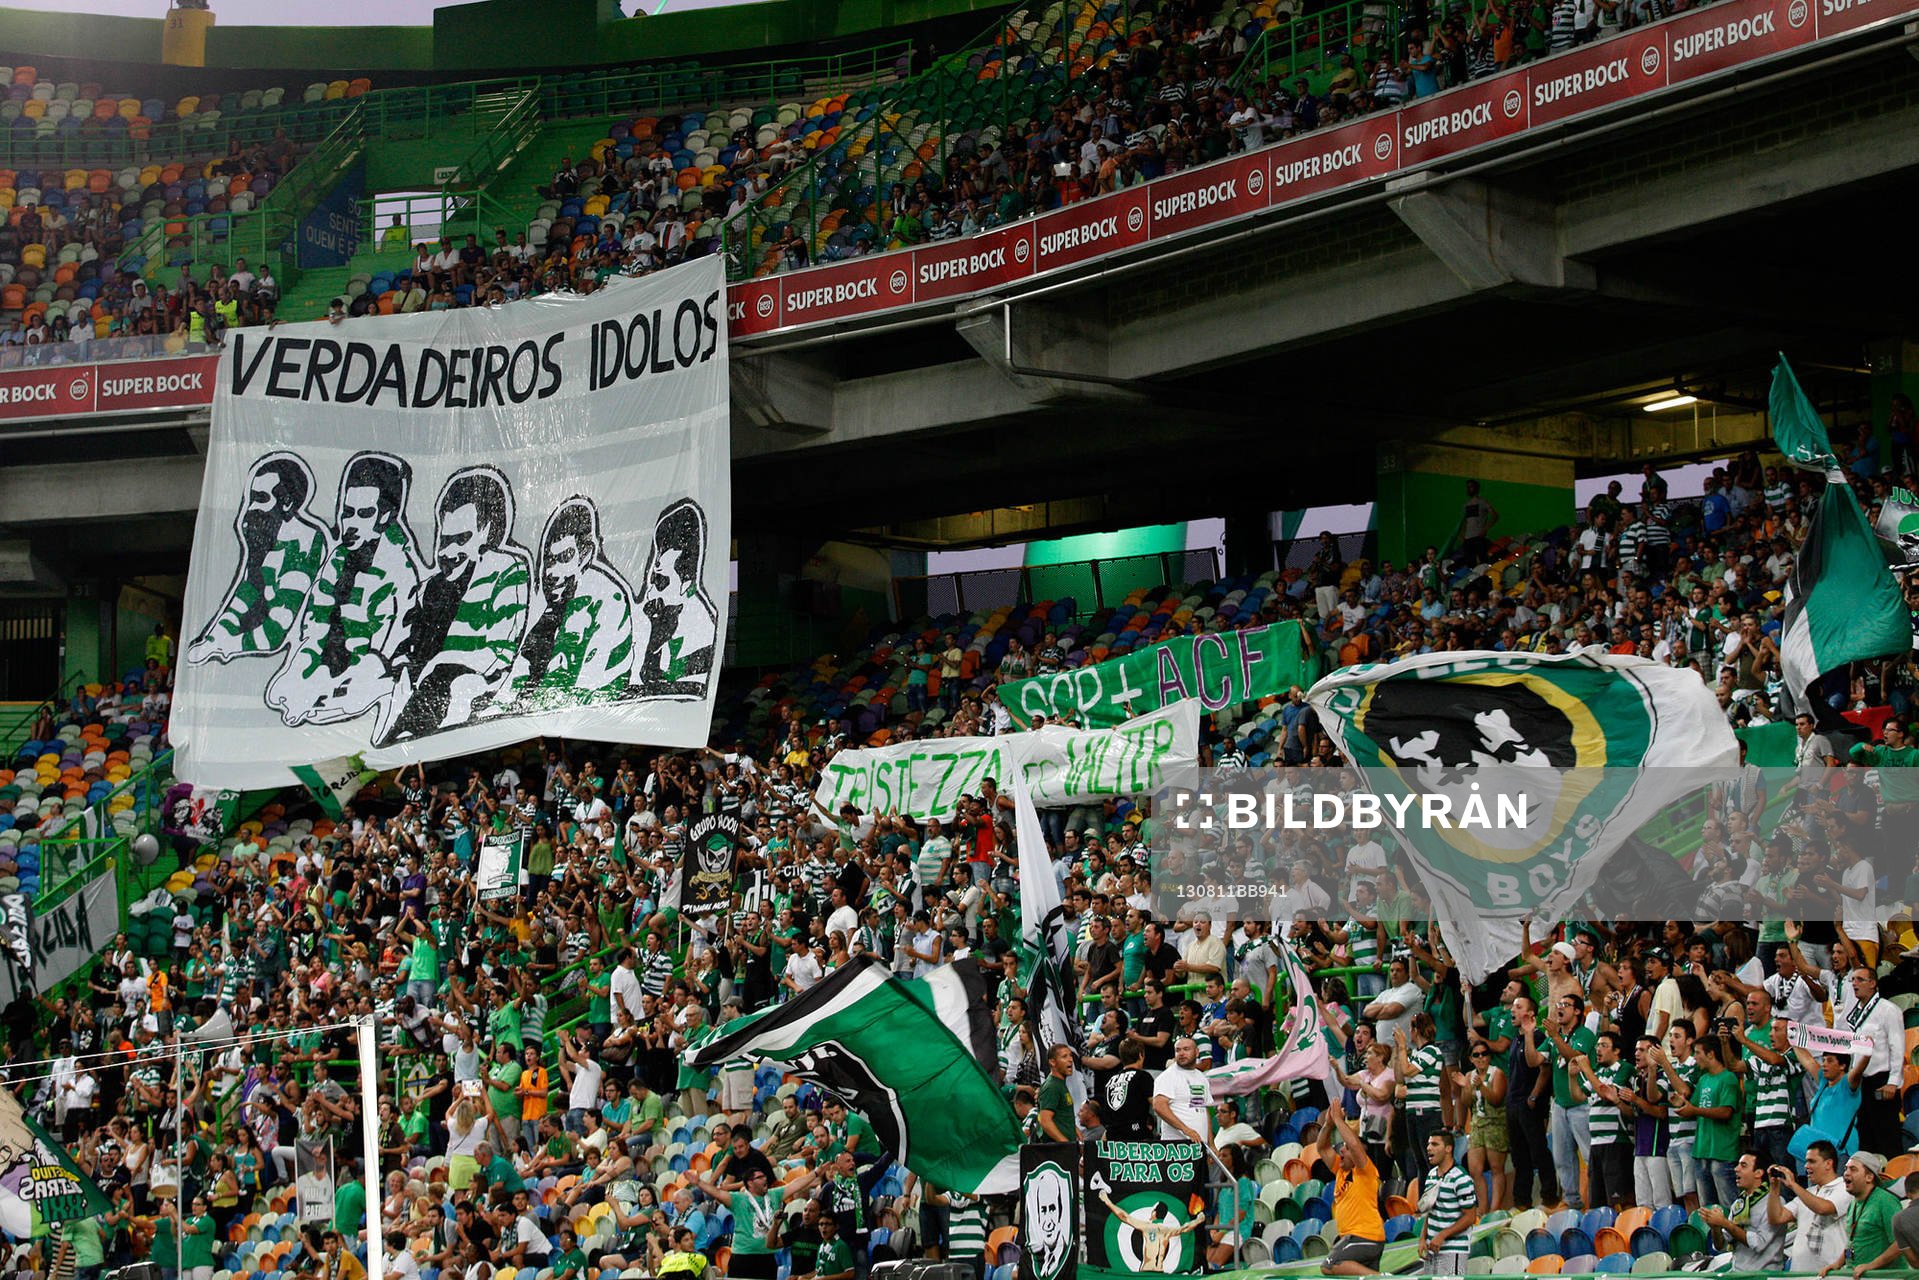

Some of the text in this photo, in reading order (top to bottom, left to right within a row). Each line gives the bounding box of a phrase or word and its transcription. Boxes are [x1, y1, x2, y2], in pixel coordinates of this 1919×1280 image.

[1674, 11, 1775, 62] SUPER BOCK
[1535, 58, 1629, 106] SUPER BOCK
[1405, 101, 1493, 148] SUPER BOCK
[1276, 143, 1362, 187] SUPER BOCK
[1154, 179, 1236, 220] SUPER BOCK
[306, 225, 335, 250] QUEM
[1040, 216, 1118, 256] SUPER BOCK
[920, 247, 1006, 284] SUPER BOCK
[727, 302, 746, 321] CK
[787, 277, 878, 312] SUPER BOCK
[232, 290, 720, 408] VERDADEIROS IDOLOS
[11, 384, 57, 403] BOCK
[102, 376, 154, 397] SUPER
[156, 373, 203, 393] BOCK
[1157, 624, 1270, 712] ACF
[1096, 1140, 1203, 1161] LIBERDADE
[1109, 1162, 1194, 1183] PARA OS
